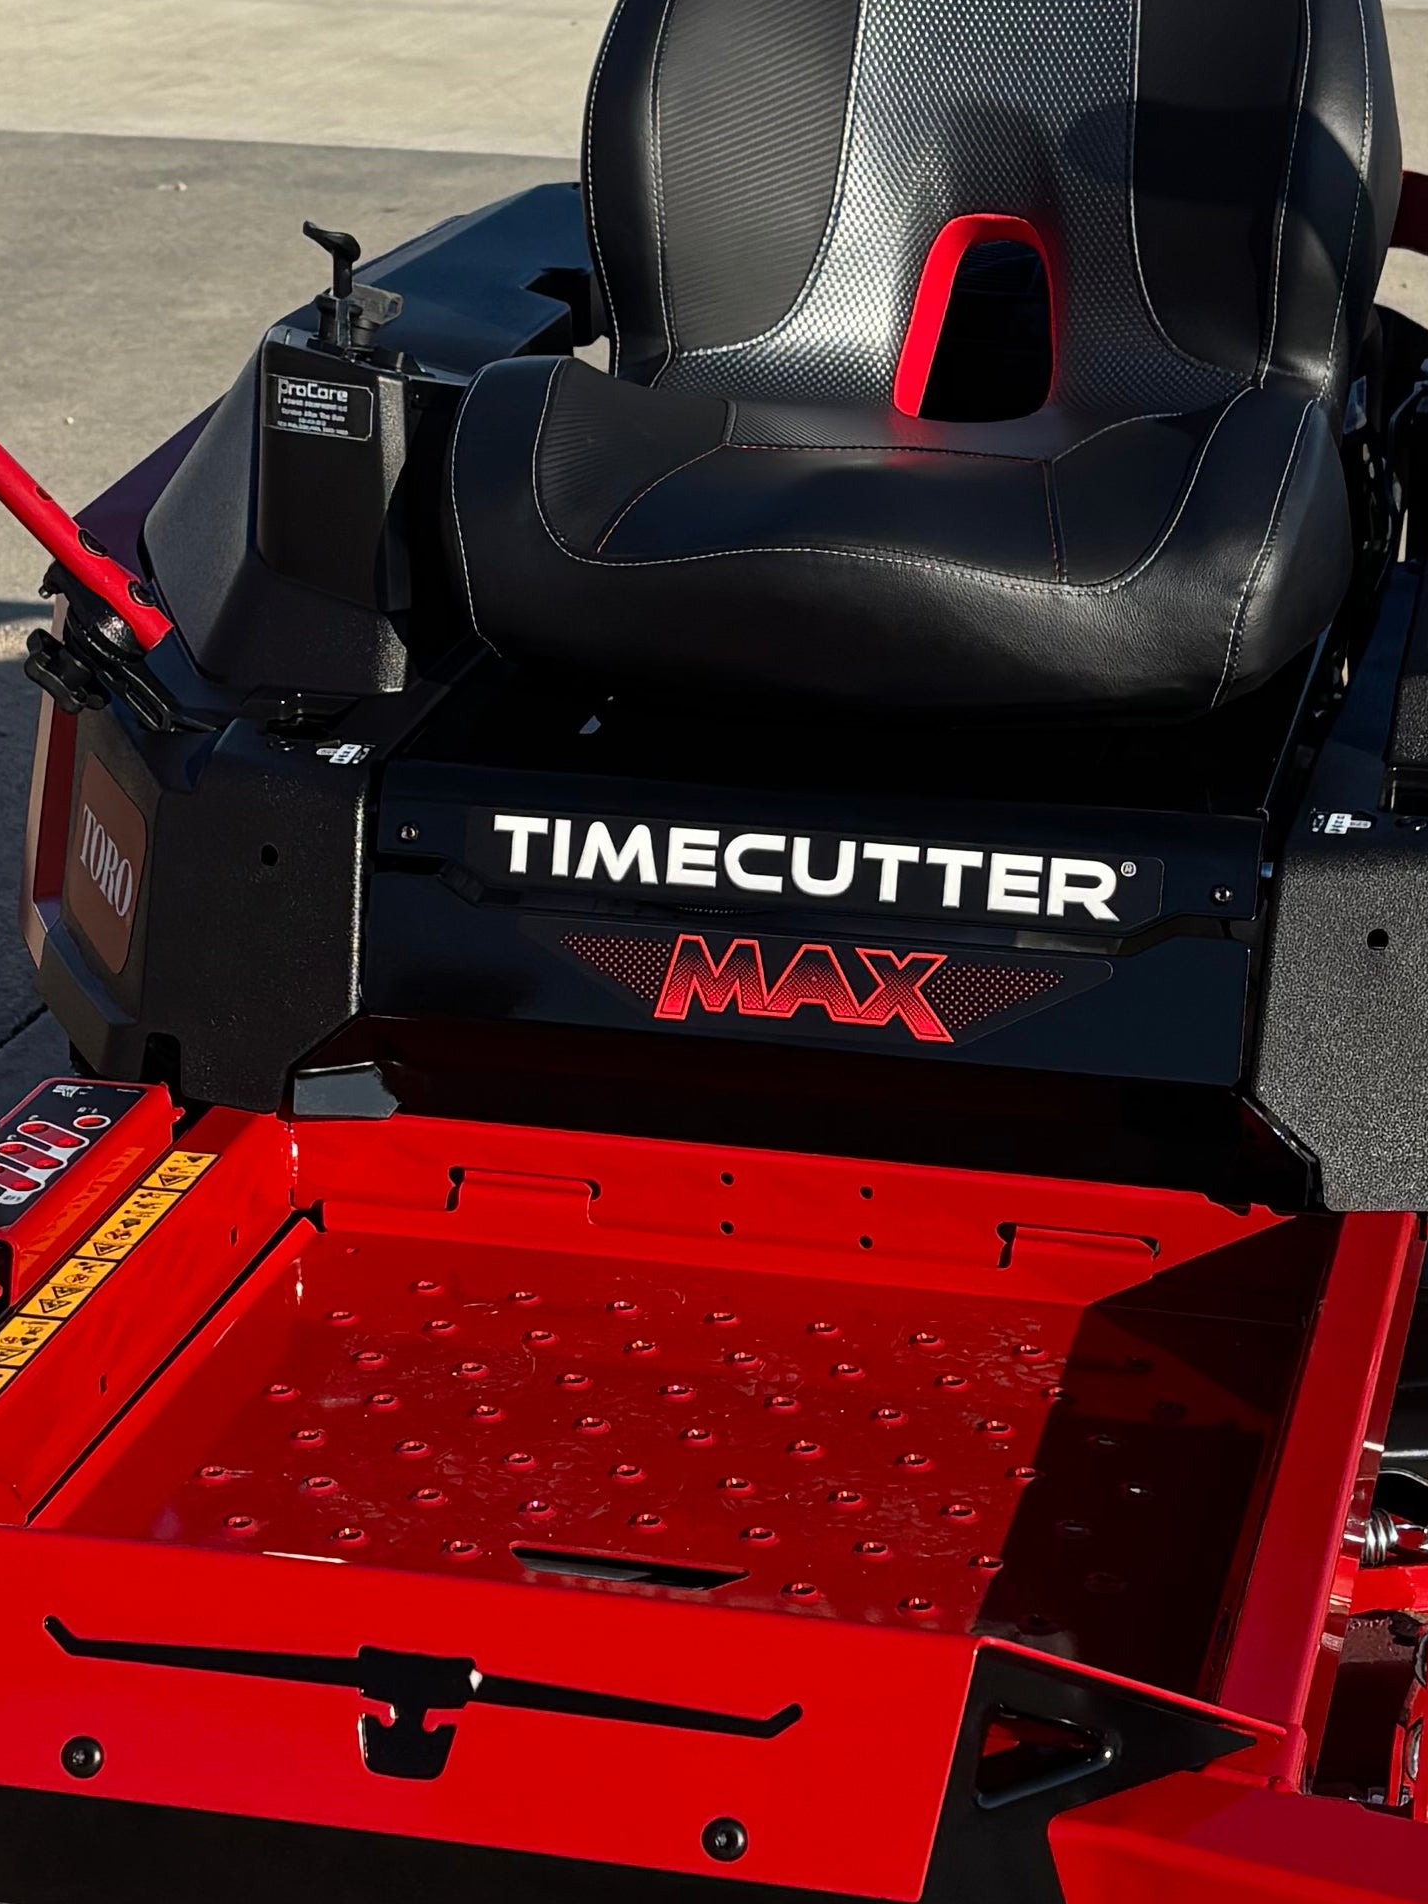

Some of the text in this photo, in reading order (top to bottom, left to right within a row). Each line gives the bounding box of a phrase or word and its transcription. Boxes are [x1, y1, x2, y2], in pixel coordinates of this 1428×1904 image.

[80, 803, 133, 916] TORO
[494, 814, 1120, 922] TIMECUTTER
[654, 933, 955, 1043] MAX
